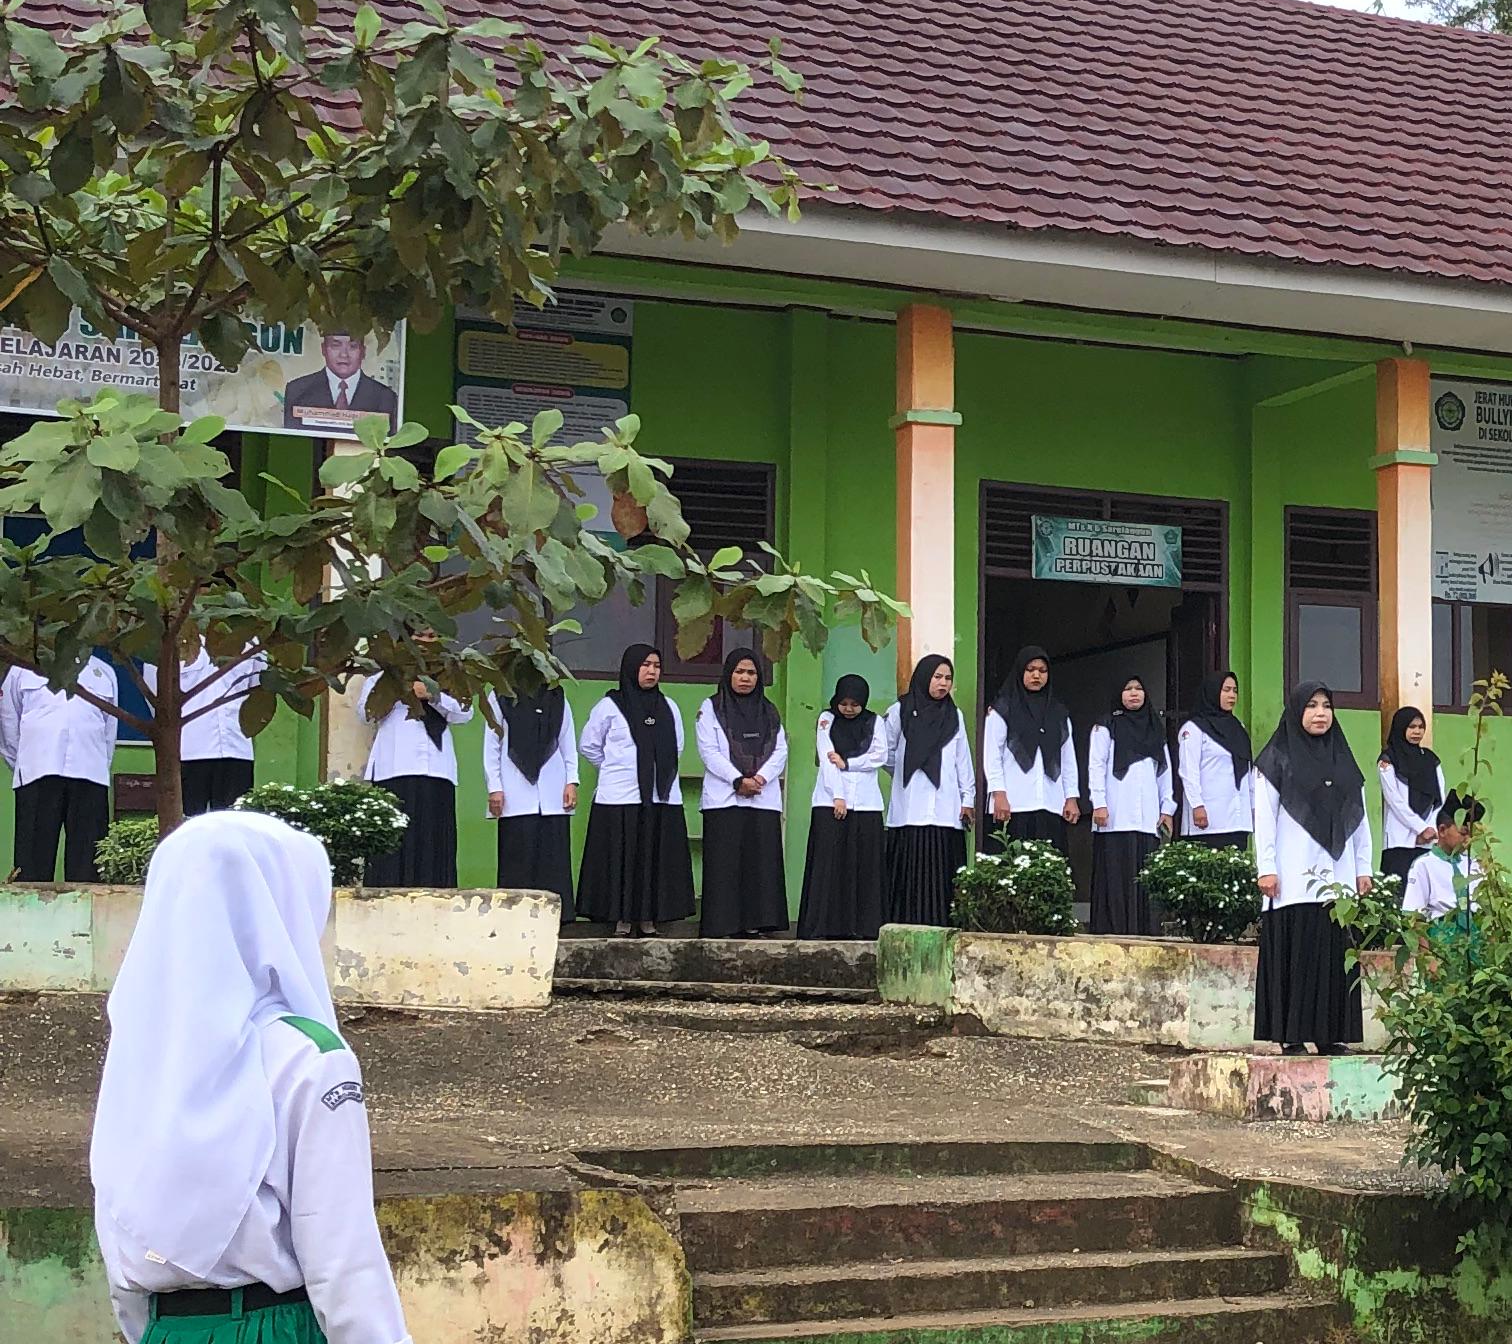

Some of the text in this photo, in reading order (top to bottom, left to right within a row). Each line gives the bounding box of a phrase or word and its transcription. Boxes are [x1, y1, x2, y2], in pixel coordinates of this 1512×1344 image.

[29, 364, 84, 382] Hebat,
[91, 369, 196, 391] Bermartat
[1474, 391, 1497, 406] JERAT
[1479, 427, 1488, 440] DI
[1064, 537, 1155, 561] RUANGAN
[1055, 558, 1164, 578] PERPUSTAKAAN
